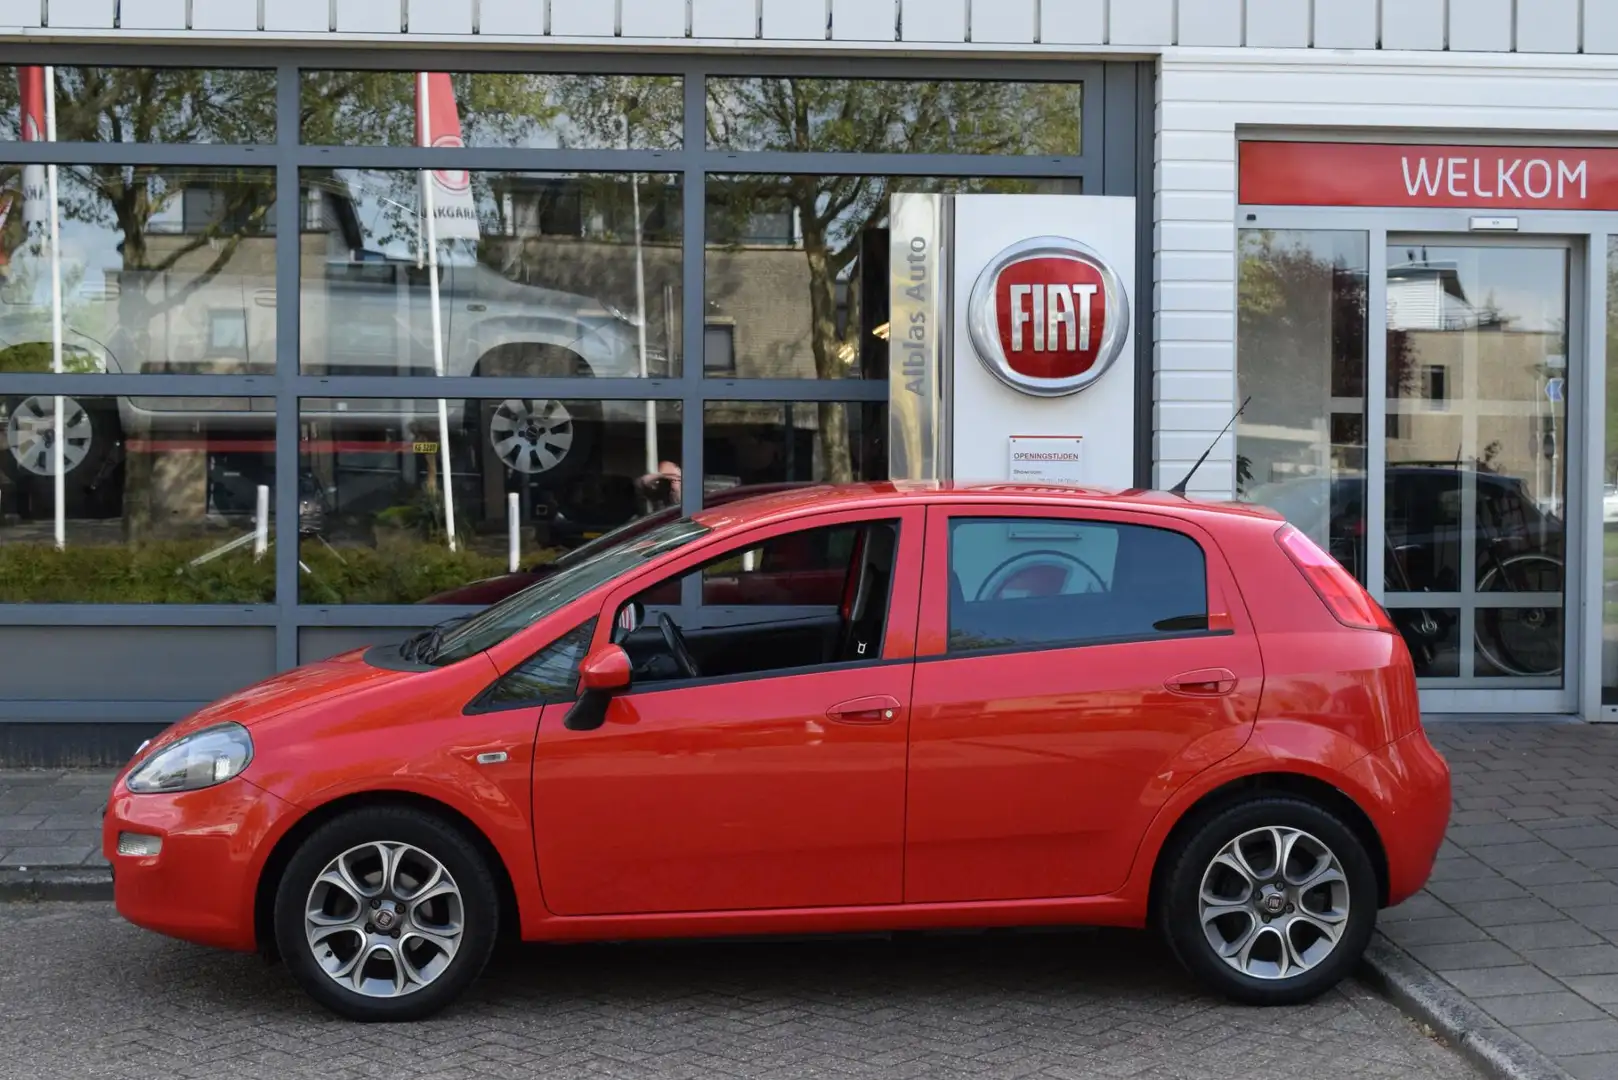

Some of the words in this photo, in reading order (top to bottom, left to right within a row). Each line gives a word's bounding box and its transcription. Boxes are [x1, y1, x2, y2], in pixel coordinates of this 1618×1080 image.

[1401, 157, 1588, 199] WELKOM
[905, 235, 927, 301] Auto
[1009, 283, 1098, 352] FIAT
[902, 311, 925, 397] Alblas
[1013, 452, 1079, 460] OPENINGSTIJDEN
